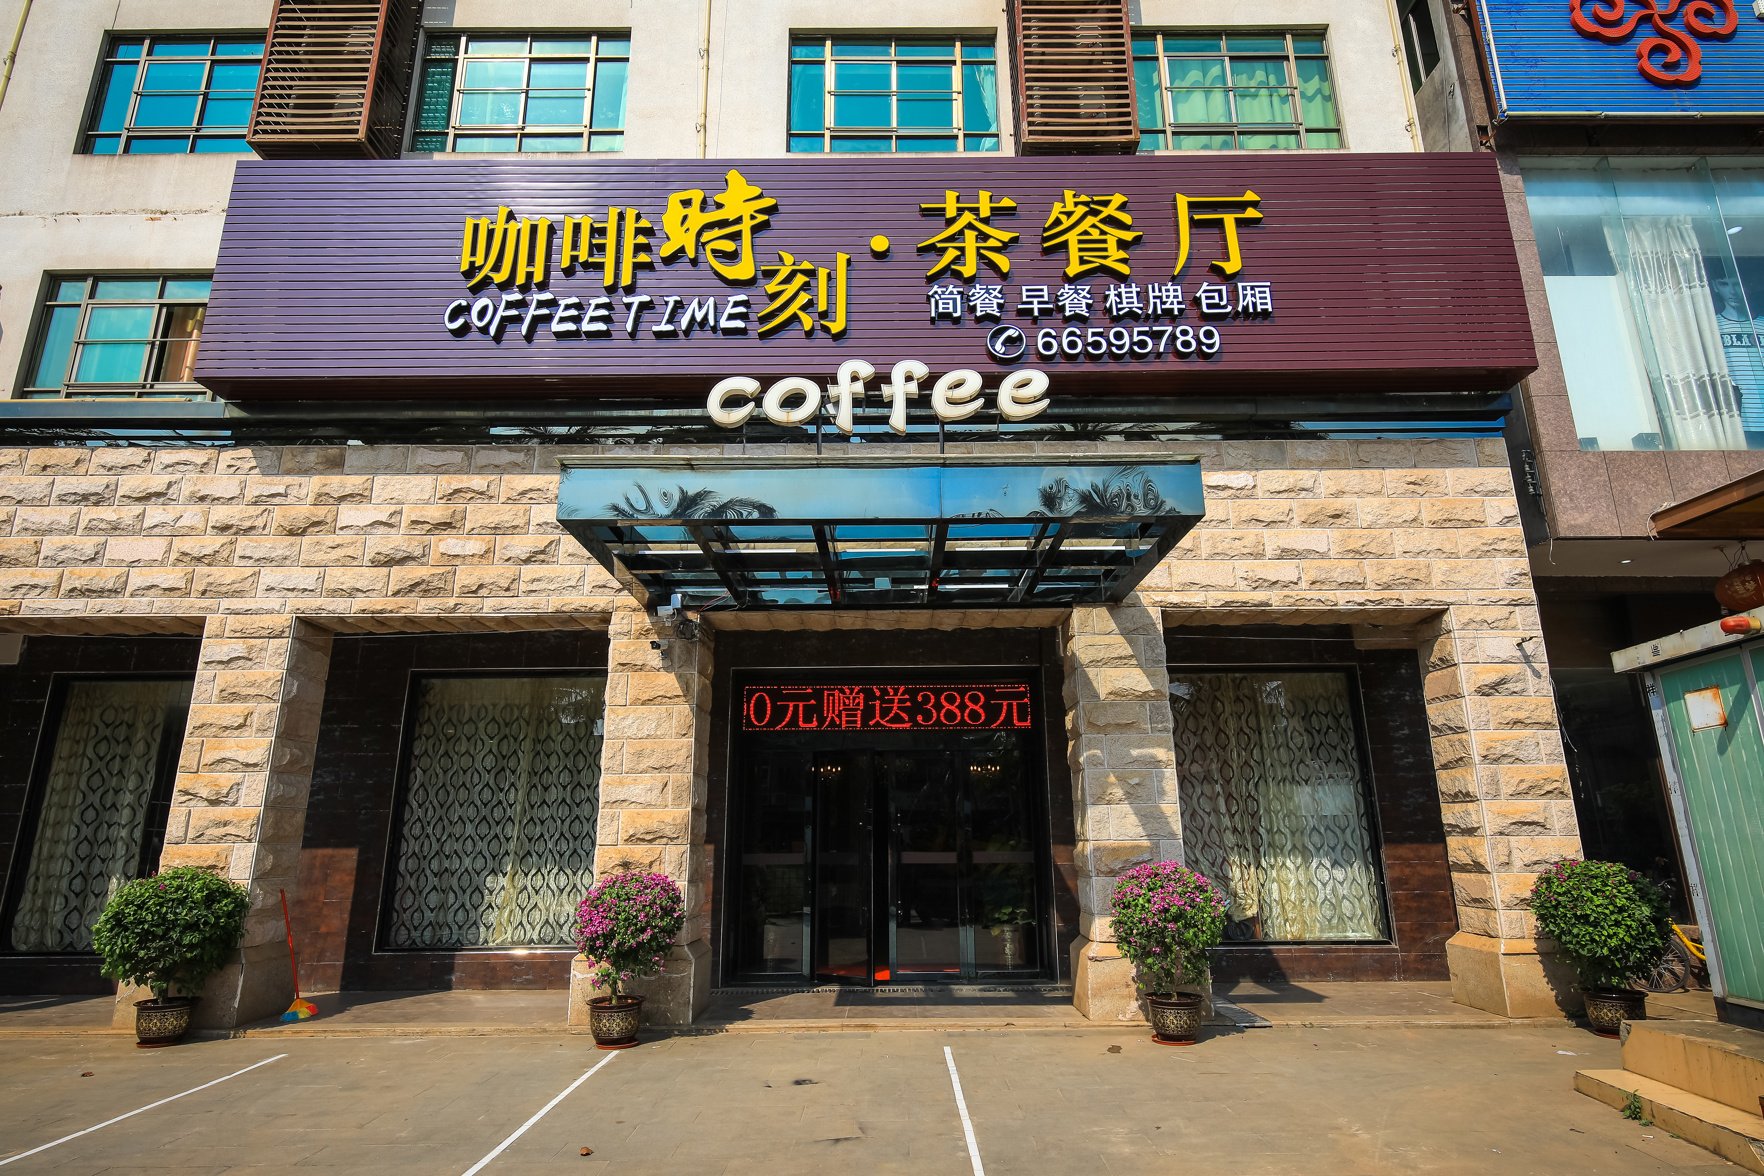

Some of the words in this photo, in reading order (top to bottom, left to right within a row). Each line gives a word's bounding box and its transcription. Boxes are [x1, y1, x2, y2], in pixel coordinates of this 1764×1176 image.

[917, 189, 1264, 280] 茶餐厅
[443, 291, 609, 342] COFFEE
[621, 294, 750, 338] TIME
[928, 284, 1005, 321] 简餐
[1017, 284, 1093, 321] 早餐
[1104, 281, 1185, 318] 棋牌
[1195, 281, 1273, 316] 包厢
[1036, 325, 1221, 357] 66595789
[706, 359, 1051, 436] coffee
[743, 686, 1031, 730] 0元赠送388元
